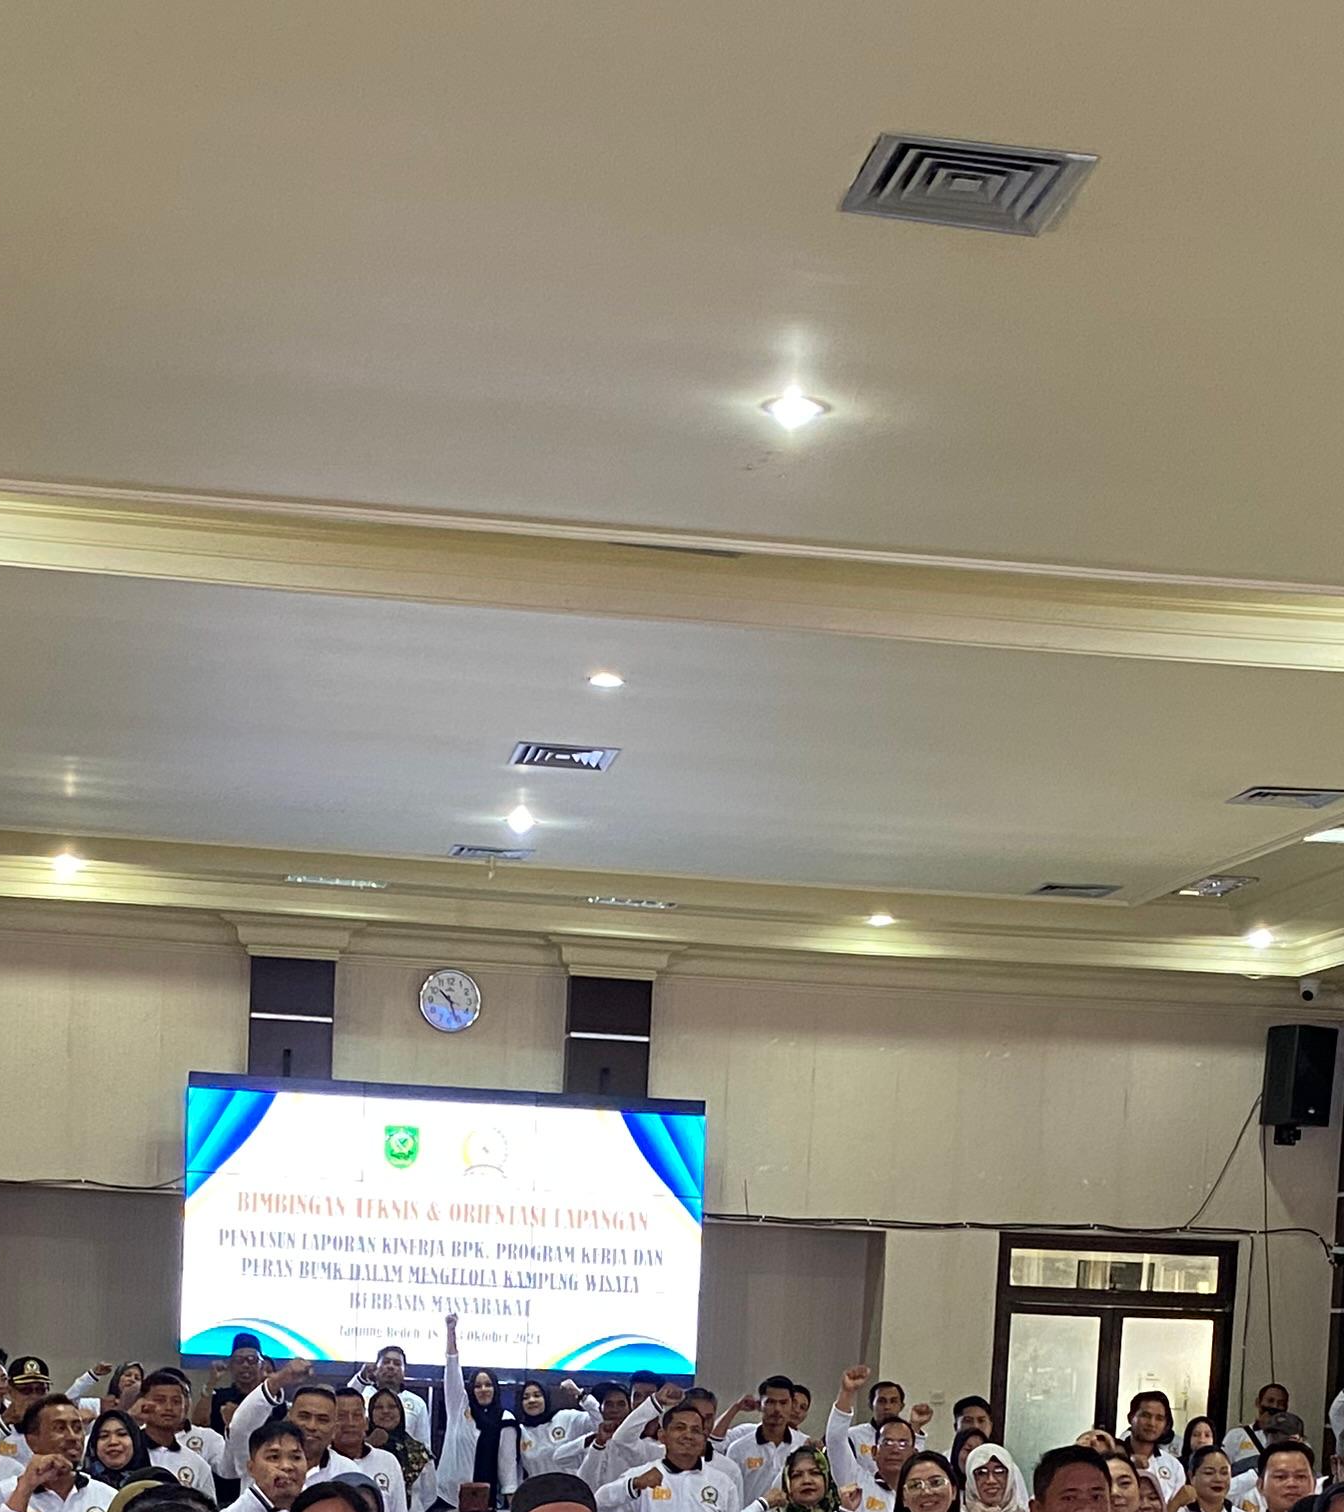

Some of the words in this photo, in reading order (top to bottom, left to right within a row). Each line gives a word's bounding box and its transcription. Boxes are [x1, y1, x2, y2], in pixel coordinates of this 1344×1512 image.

[237, 1191, 345, 1217] BIMBINGAN
[356, 1197, 419, 1221] TEKNIS
[427, 1202, 440, 1222] &
[449, 1203, 546, 1228] ORIENTASI
[554, 1209, 648, 1232] LAPANGAN
[219, 1228, 296, 1249] PENYUSUN
[302, 1232, 376, 1254] LAPORAN
[382, 1236, 445, 1258] KINERJA
[496, 1243, 575, 1264] PROGRAM
[581, 1247, 627, 1266] KERJA
[634, 1248, 663, 1266] DAN
[241, 1257, 293, 1278] PERAN
[299, 1260, 343, 1280] BUMK
[350, 1263, 403, 1284] DALAM
[408, 1265, 498, 1288] MENGELOLA
[502, 1270, 578, 1291] KAMPUNG
[585, 1274, 639, 1294] WISATA
[349, 1291, 425, 1312] BERBASIS
[431, 1295, 531, 1317] MASYARAKAT
